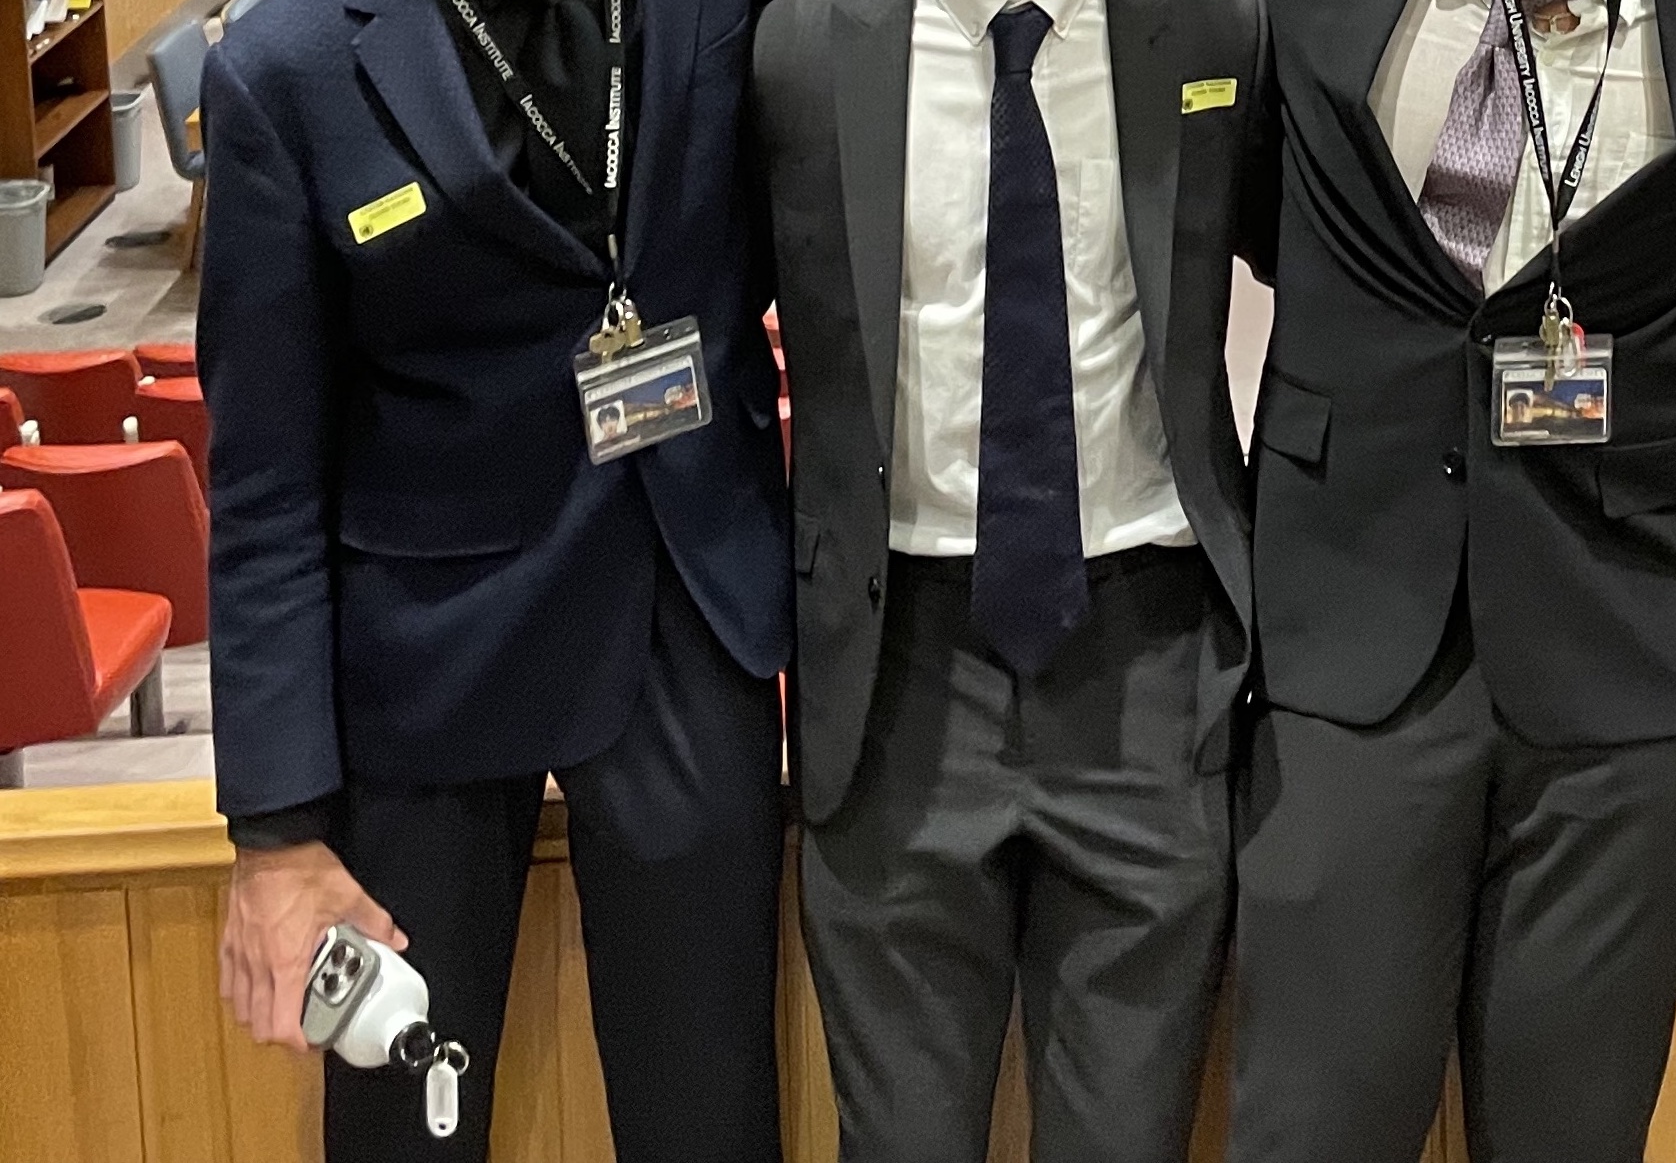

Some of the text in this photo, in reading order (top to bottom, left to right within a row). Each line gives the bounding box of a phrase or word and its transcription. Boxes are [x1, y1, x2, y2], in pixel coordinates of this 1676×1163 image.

[473, 22, 513, 81] INSTITUTE
[1509, 13, 1530, 76] UNIVERSITY
[1523, 78, 1540, 126] IACOCCA
[520, 94, 556, 146] IACOCCA
[604, 66, 622, 188] IACOCCA INSTITUTE
[1564, 146, 1587, 187] LEHIGH
